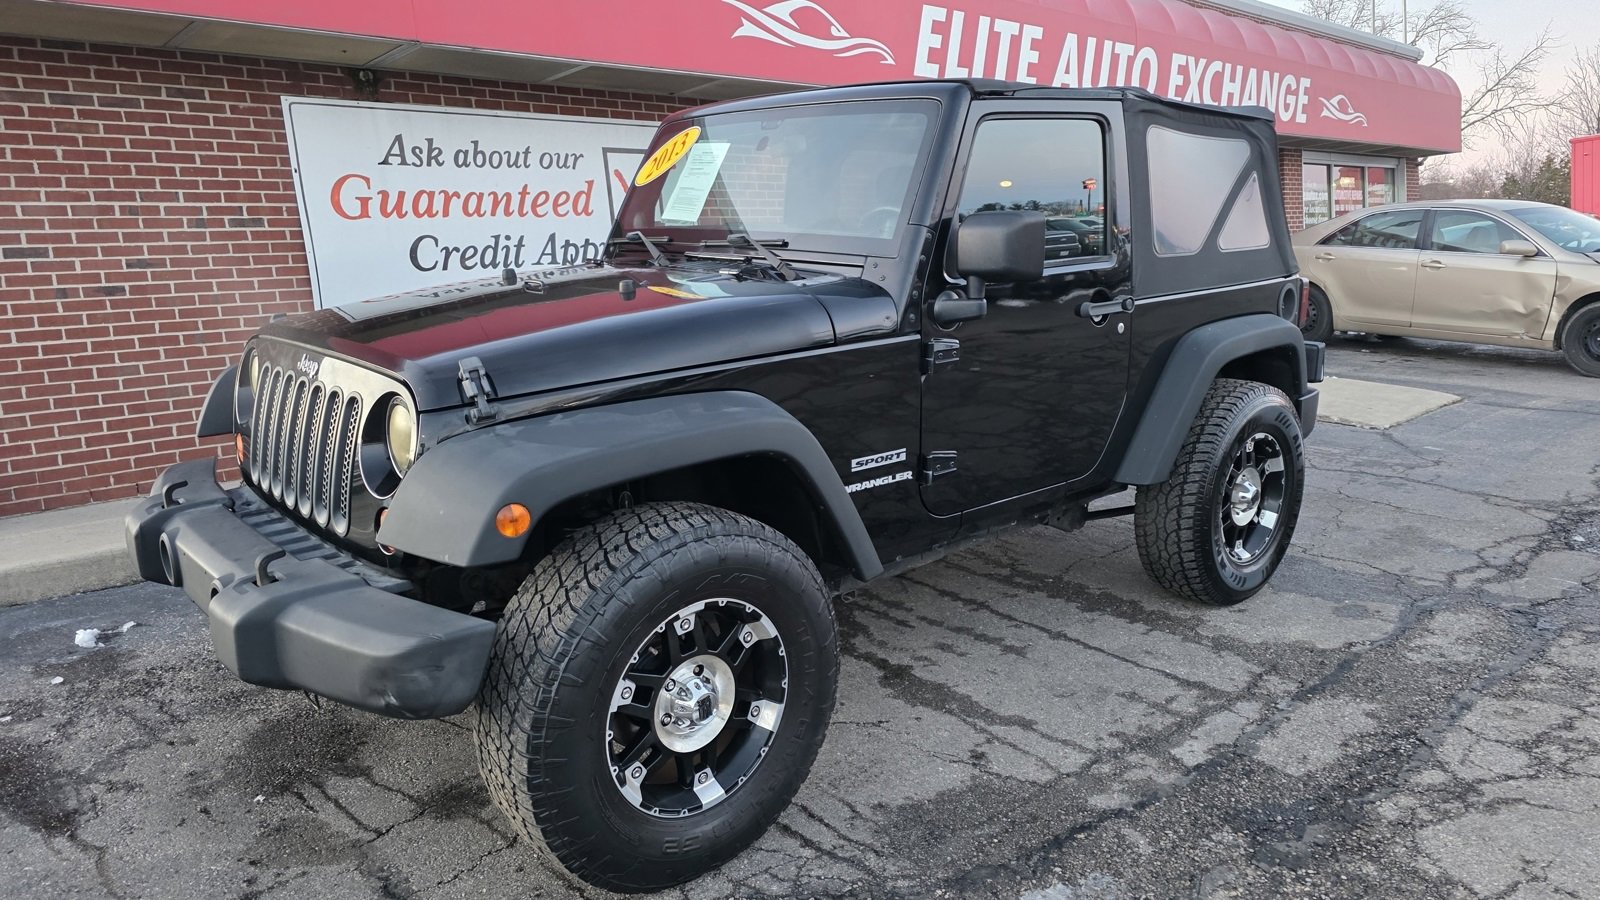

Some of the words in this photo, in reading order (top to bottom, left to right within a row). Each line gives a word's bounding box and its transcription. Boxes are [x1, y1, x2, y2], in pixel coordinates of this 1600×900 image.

[914, 4, 1044, 85] ELITE
[1051, 32, 1158, 93] AUTO
[1167, 52, 1311, 123] EXCHANGE
[377, 133, 445, 168] Ask
[453, 140, 532, 169] about
[539, 151, 584, 170] our
[644, 131, 690, 181] 2013
[330, 173, 595, 220] Guaranteed
[409, 233, 526, 272] Credit
[297, 353, 319, 379] Jeep
[853, 451, 904, 468] SPORT
